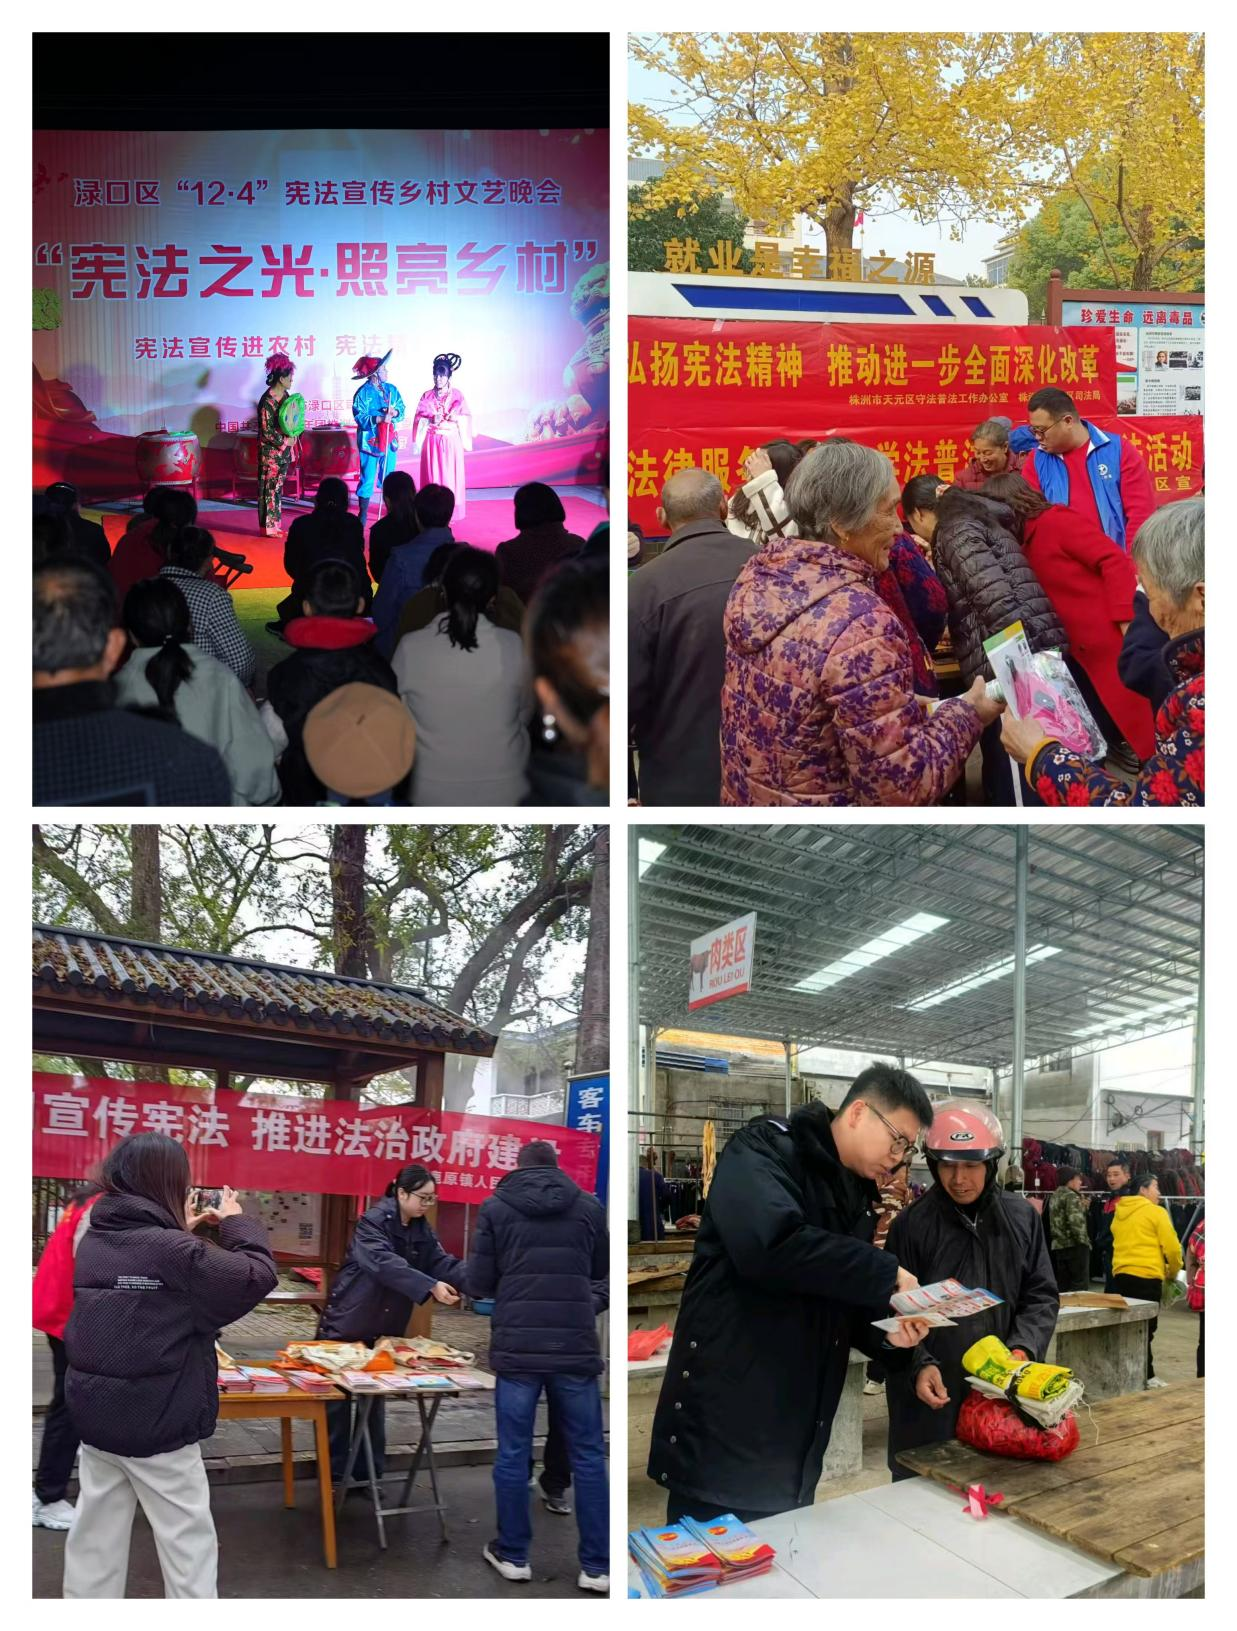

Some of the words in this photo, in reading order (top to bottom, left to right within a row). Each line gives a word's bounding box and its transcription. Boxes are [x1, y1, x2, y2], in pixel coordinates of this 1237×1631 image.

[73, 178, 160, 205] 渌口区
[285, 179, 561, 206] 宪法宣传乡村文艺晚会
[664, 238, 936, 285] 就业是幸福之源
[1081, 309, 1134, 324] 珍爱生命
[1143, 310, 1193, 326] 远离毒品
[135, 335, 316, 359] 宪法宣传进农村
[827, 343, 1099, 387] 推动进一步全面深化改革
[849, 392, 1009, 406] 株洲市天元区守法普法工作办公室
[709, 926, 748, 974] 肉类区
[32, 1092, 230, 1148] 宣传宪法
